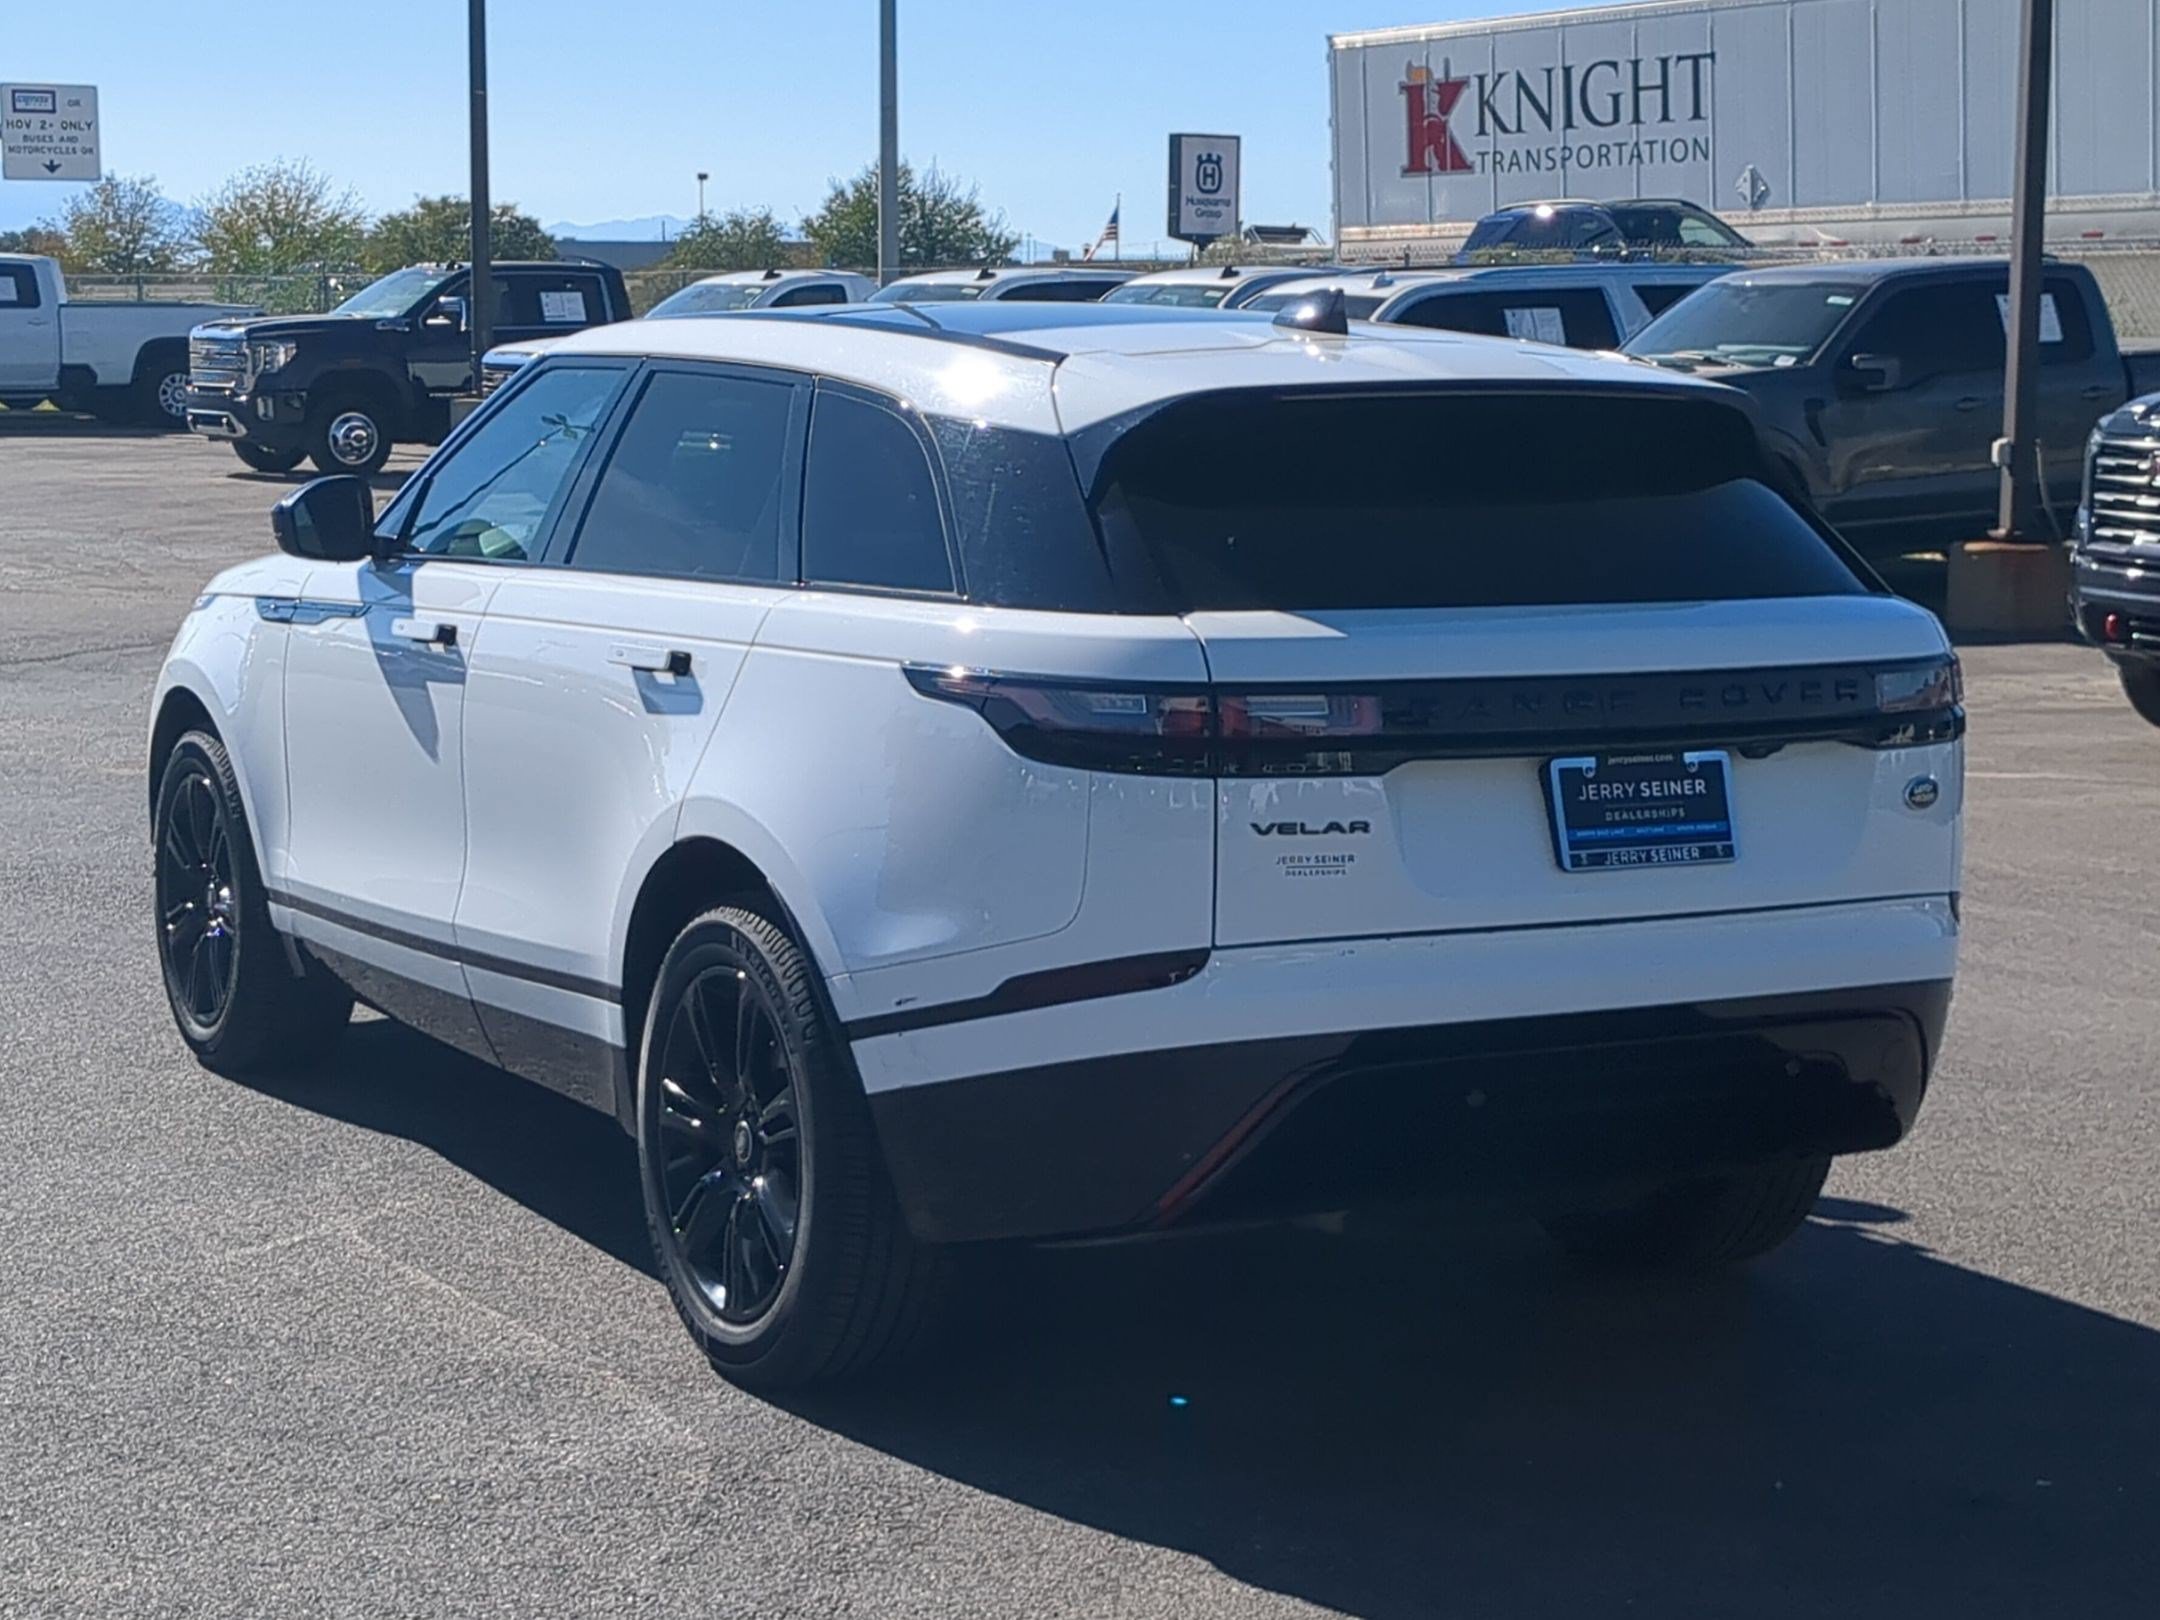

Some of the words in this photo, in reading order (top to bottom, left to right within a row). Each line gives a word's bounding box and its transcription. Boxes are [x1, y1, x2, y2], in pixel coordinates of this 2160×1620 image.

[1473, 51, 1716, 137] KNIGHT
[6, 119, 32, 130] HOV
[60, 120, 93, 132] ONLY
[22, 134, 54, 144] BUSES
[59, 135, 79, 144] AND
[8, 145, 77, 155] MOTORCYCLES
[1475, 136, 1710, 174] TRANSPORTATION
[1578, 782, 1636, 801] JERRY
[1639, 779, 1707, 798] SEINER
[1605, 807, 1686, 822] DEALERSHIPS
[1249, 821, 1371, 836] VELAR
[1275, 855, 1311, 865] JERRY
[1313, 853, 1355, 864] SEINER
[1604, 850, 1648, 865] JERRY
[1650, 846, 1701, 862] SEINER
[1284, 868, 1347, 877] DEALERSHIPS
